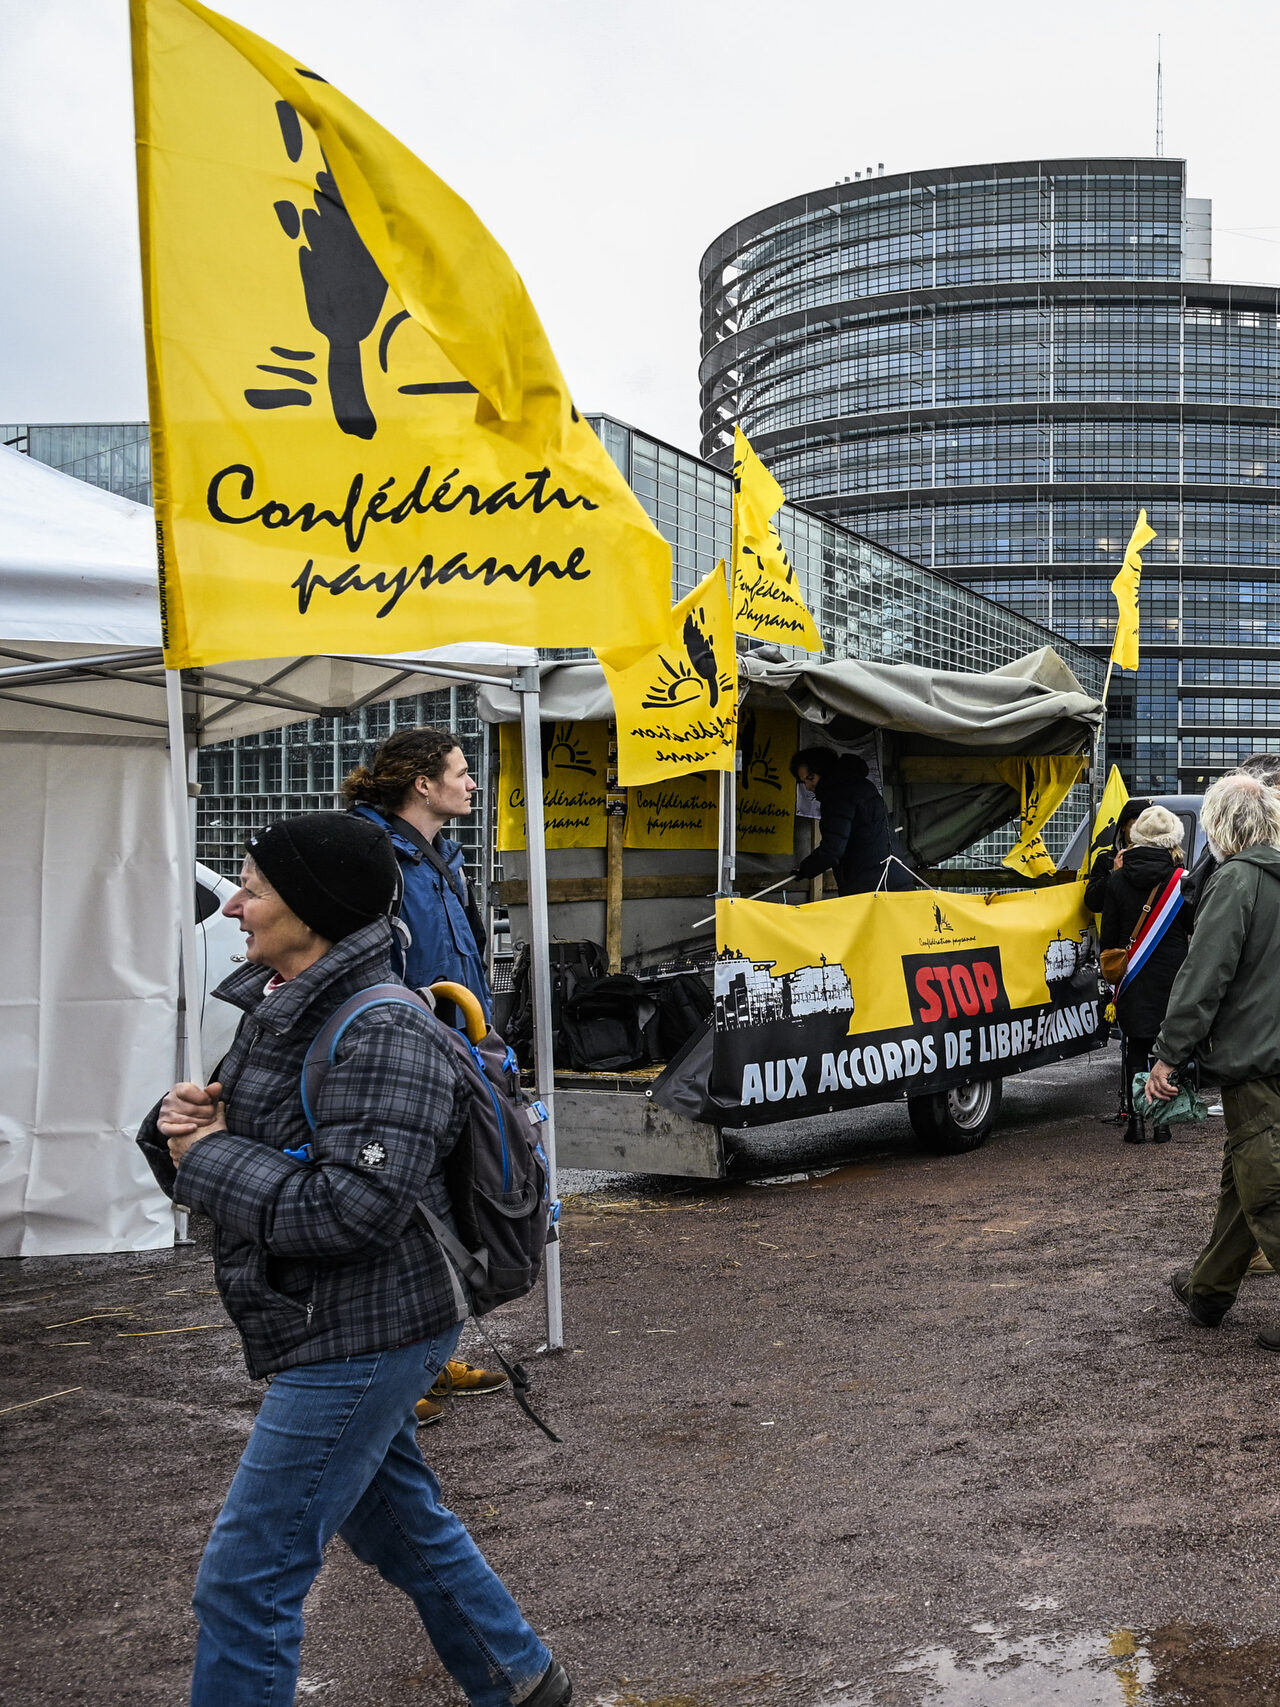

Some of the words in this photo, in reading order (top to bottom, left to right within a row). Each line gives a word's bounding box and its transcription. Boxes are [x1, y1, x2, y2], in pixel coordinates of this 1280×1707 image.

[291, 547, 591, 618] paysanne
[915, 961, 998, 1023] STOP
[741, 1056, 808, 1106] AUX
[818, 1039, 937, 1093] ACCORDS
[944, 1028, 971, 1068] DE
